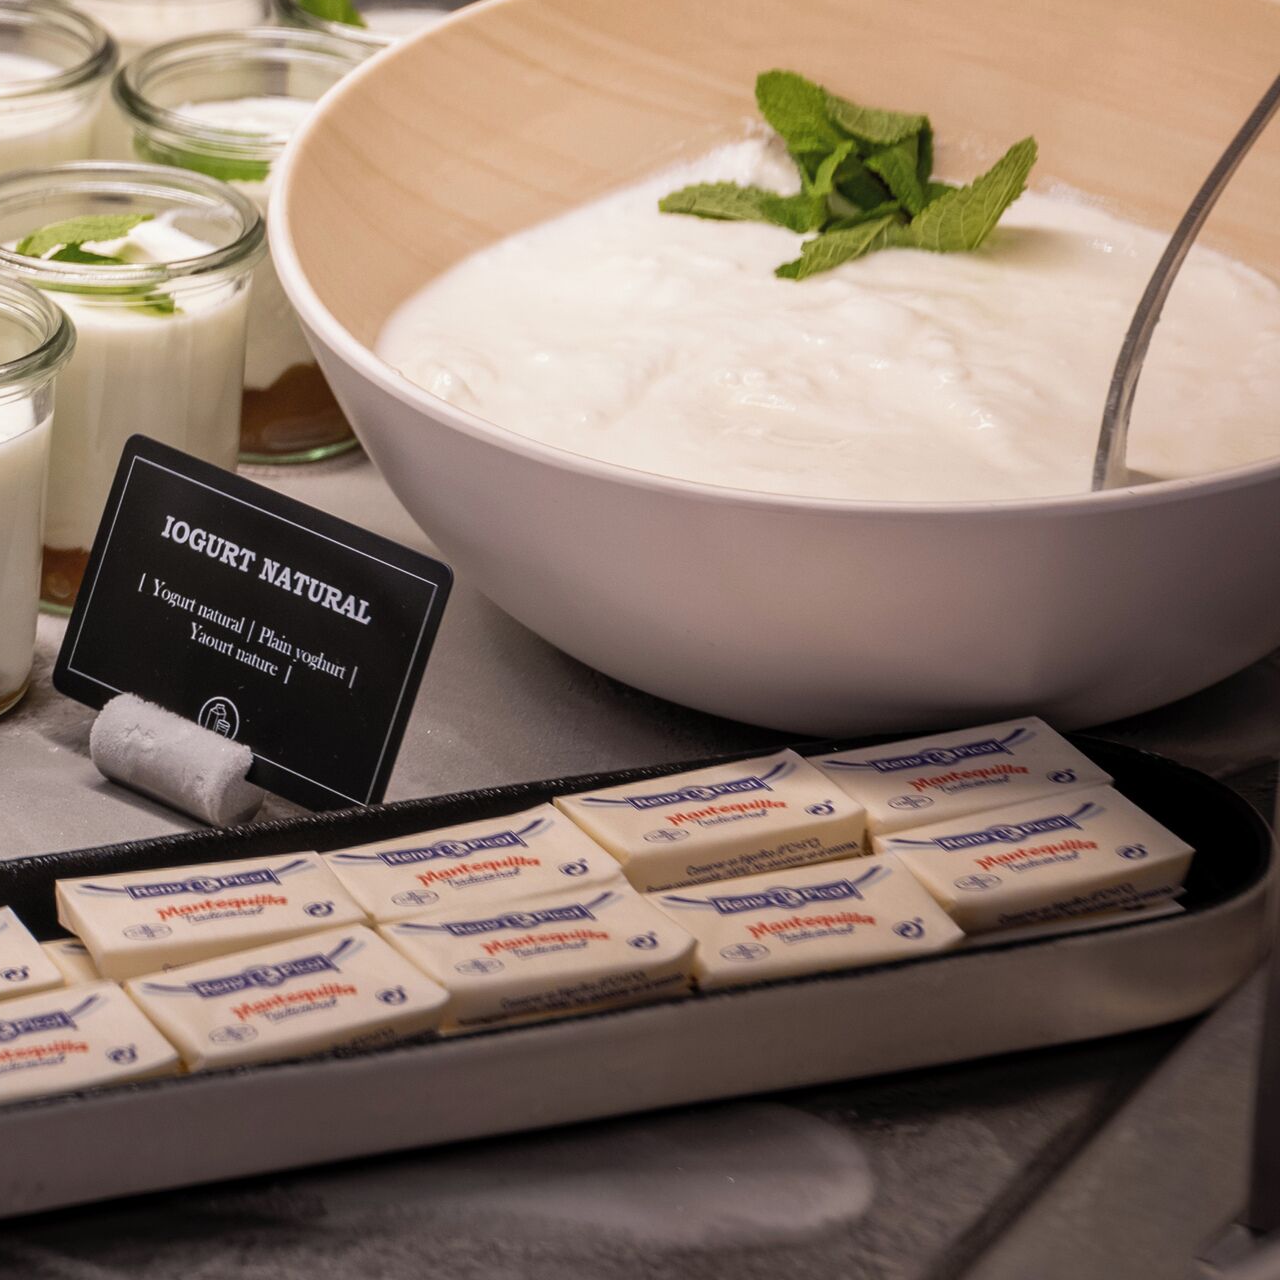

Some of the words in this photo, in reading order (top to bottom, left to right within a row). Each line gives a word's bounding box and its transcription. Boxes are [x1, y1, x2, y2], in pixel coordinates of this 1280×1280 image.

[161, 516, 256, 573] IOGURT
[259, 557, 371, 625] NATURAL
[153, 578, 197, 613] Yogurt
[197, 603, 245, 634] natural
[259, 626, 292, 656] Plain
[293, 645, 347, 680] yoghurt
[190, 622, 235, 656] Yaourt
[236, 647, 279, 677] nature
[876, 755, 922, 770] Reny
[954, 741, 999, 757] Picot
[908, 764, 1030, 792] Mantequilla
[636, 792, 681, 808] Reny
[713, 779, 758, 795] Picot
[665, 800, 789, 827] Mantequilla
[387, 850, 434, 865] Reny
[469, 835, 514, 850] Picot
[975, 840, 1098, 870] Mantequilla
[416, 856, 540, 887] Mantequilla
[135, 884, 182, 898] Reny
[802, 884, 849, 900] Picot
[157, 894, 288, 920] Mantequilla
[746, 912, 876, 940] Mantequilla
